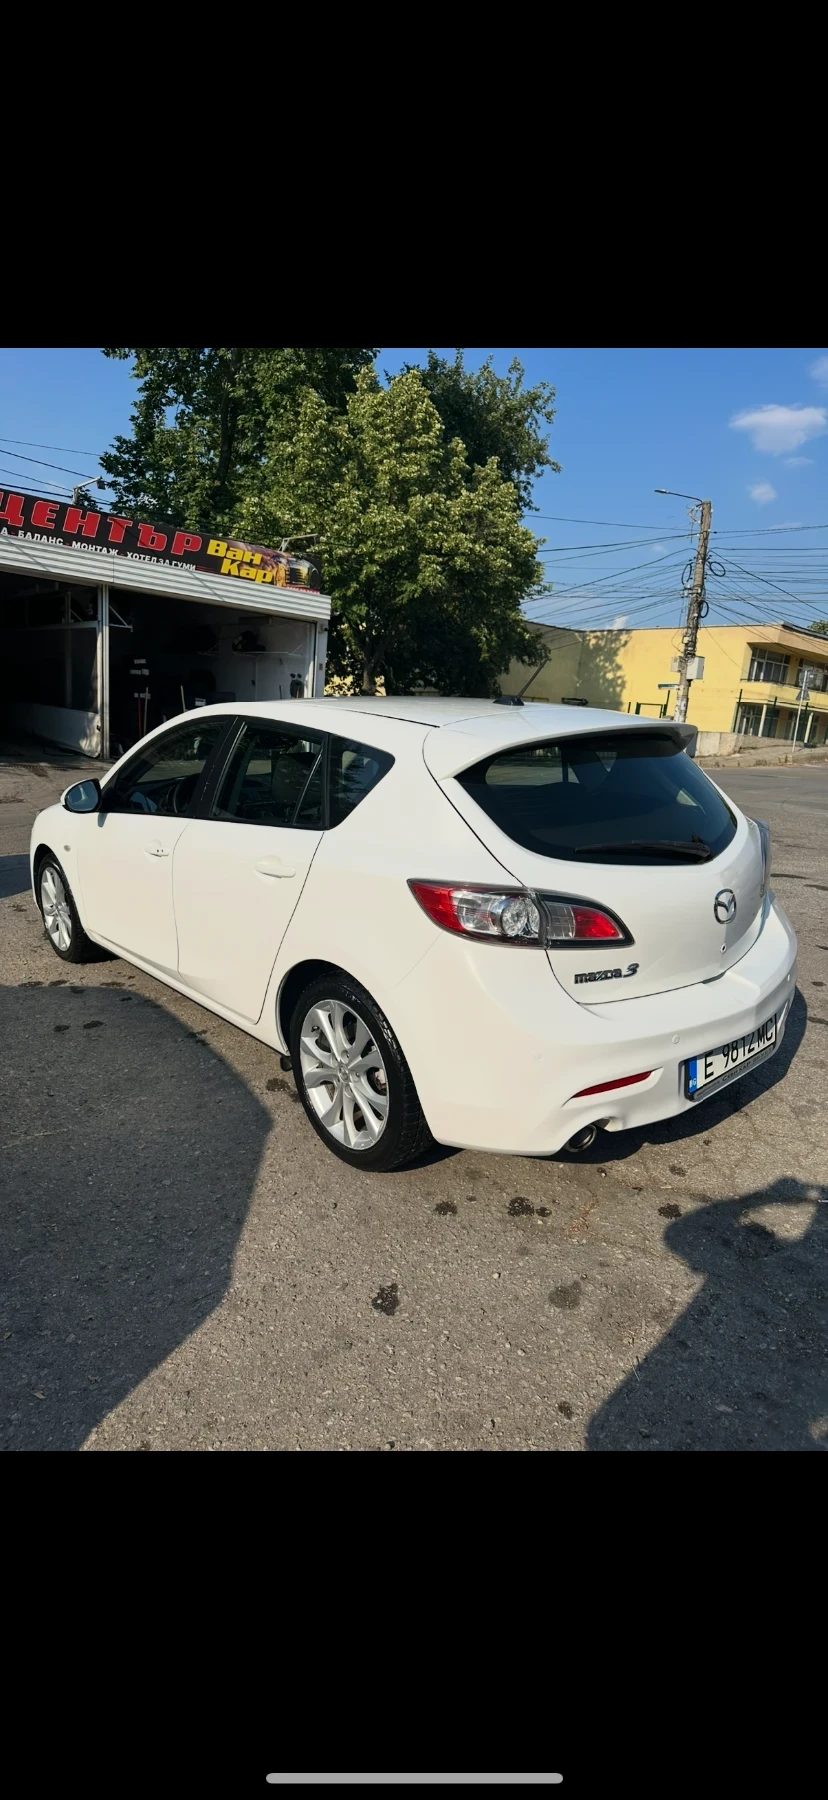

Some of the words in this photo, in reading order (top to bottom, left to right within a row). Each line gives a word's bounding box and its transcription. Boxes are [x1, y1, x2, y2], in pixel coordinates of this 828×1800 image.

[0, 491, 203, 556] ЦЕНТЪР
[18, 530, 64, 546] БАЛАНС
[71, 541, 119, 556] МОНТАЖ
[126, 552, 159, 564] ХОТЕЛ
[158, 559, 170, 567] ЗА
[171, 560, 197, 572] ГУМИ
[206, 539, 263, 566] Ван
[220, 558, 274, 584] Кар
[622, 962, 640, 978] 3
[704, 1050, 715, 1080] E
[722, 1032, 755, 1069] 9812
